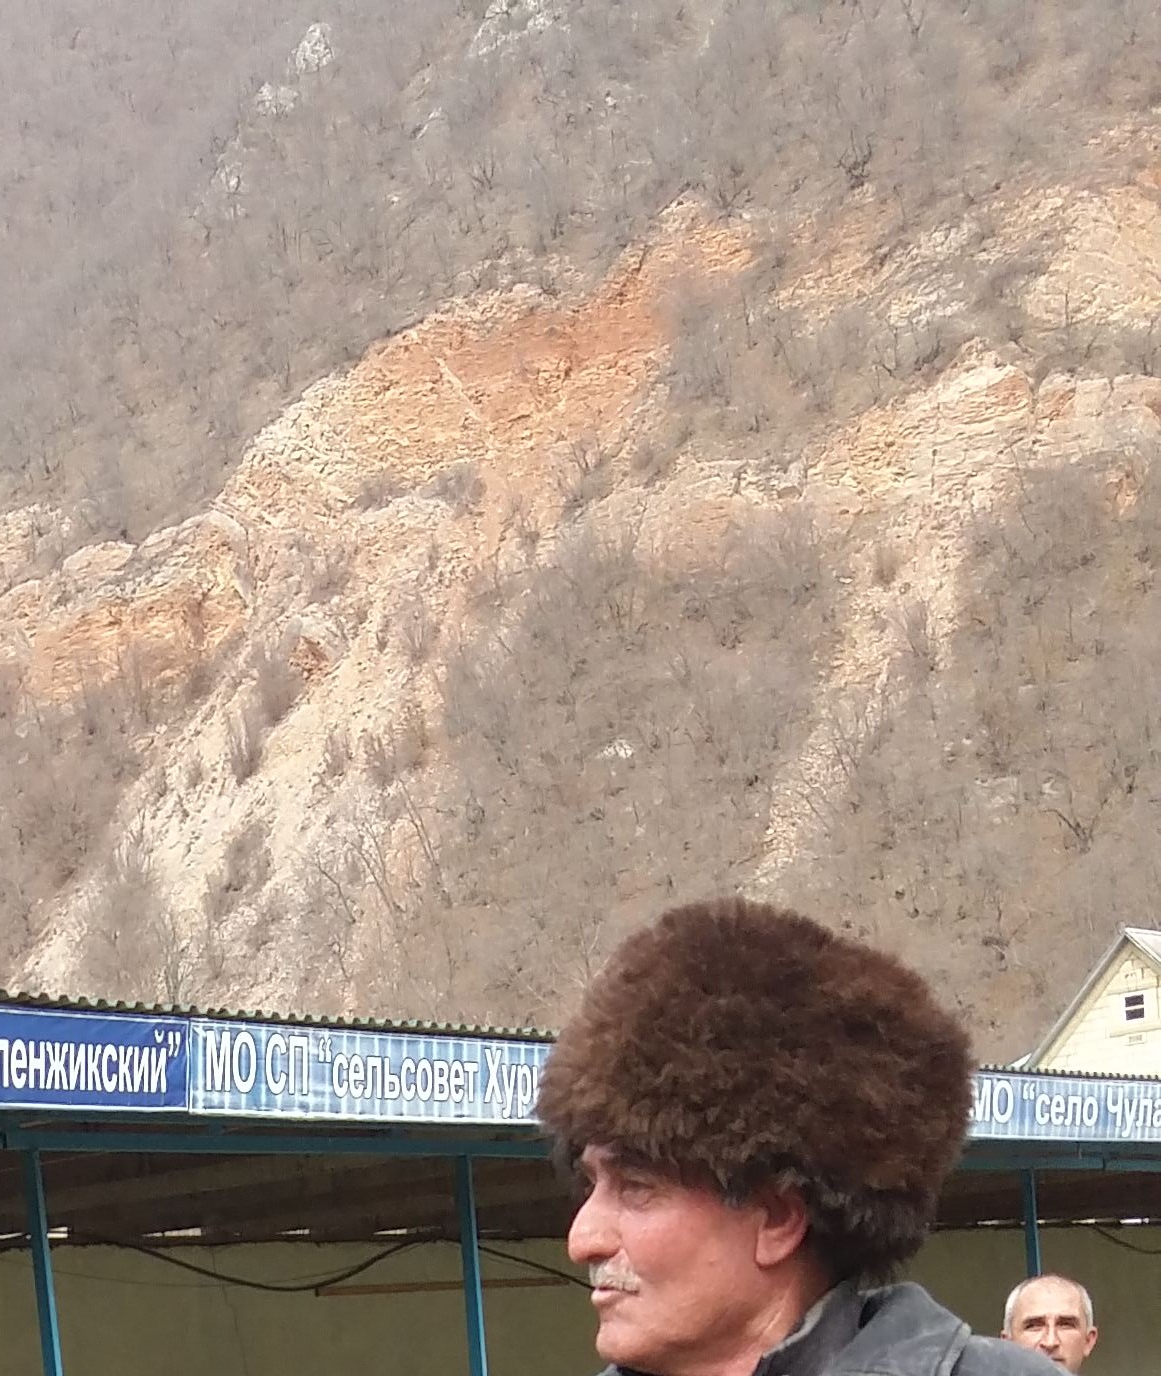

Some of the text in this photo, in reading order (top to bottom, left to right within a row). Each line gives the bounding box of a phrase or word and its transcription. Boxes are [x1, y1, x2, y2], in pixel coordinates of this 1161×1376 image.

[205, 1030, 539, 1119] МО СП “сельсовет Хур
[1022, 1082, 1099, 1128] “село
